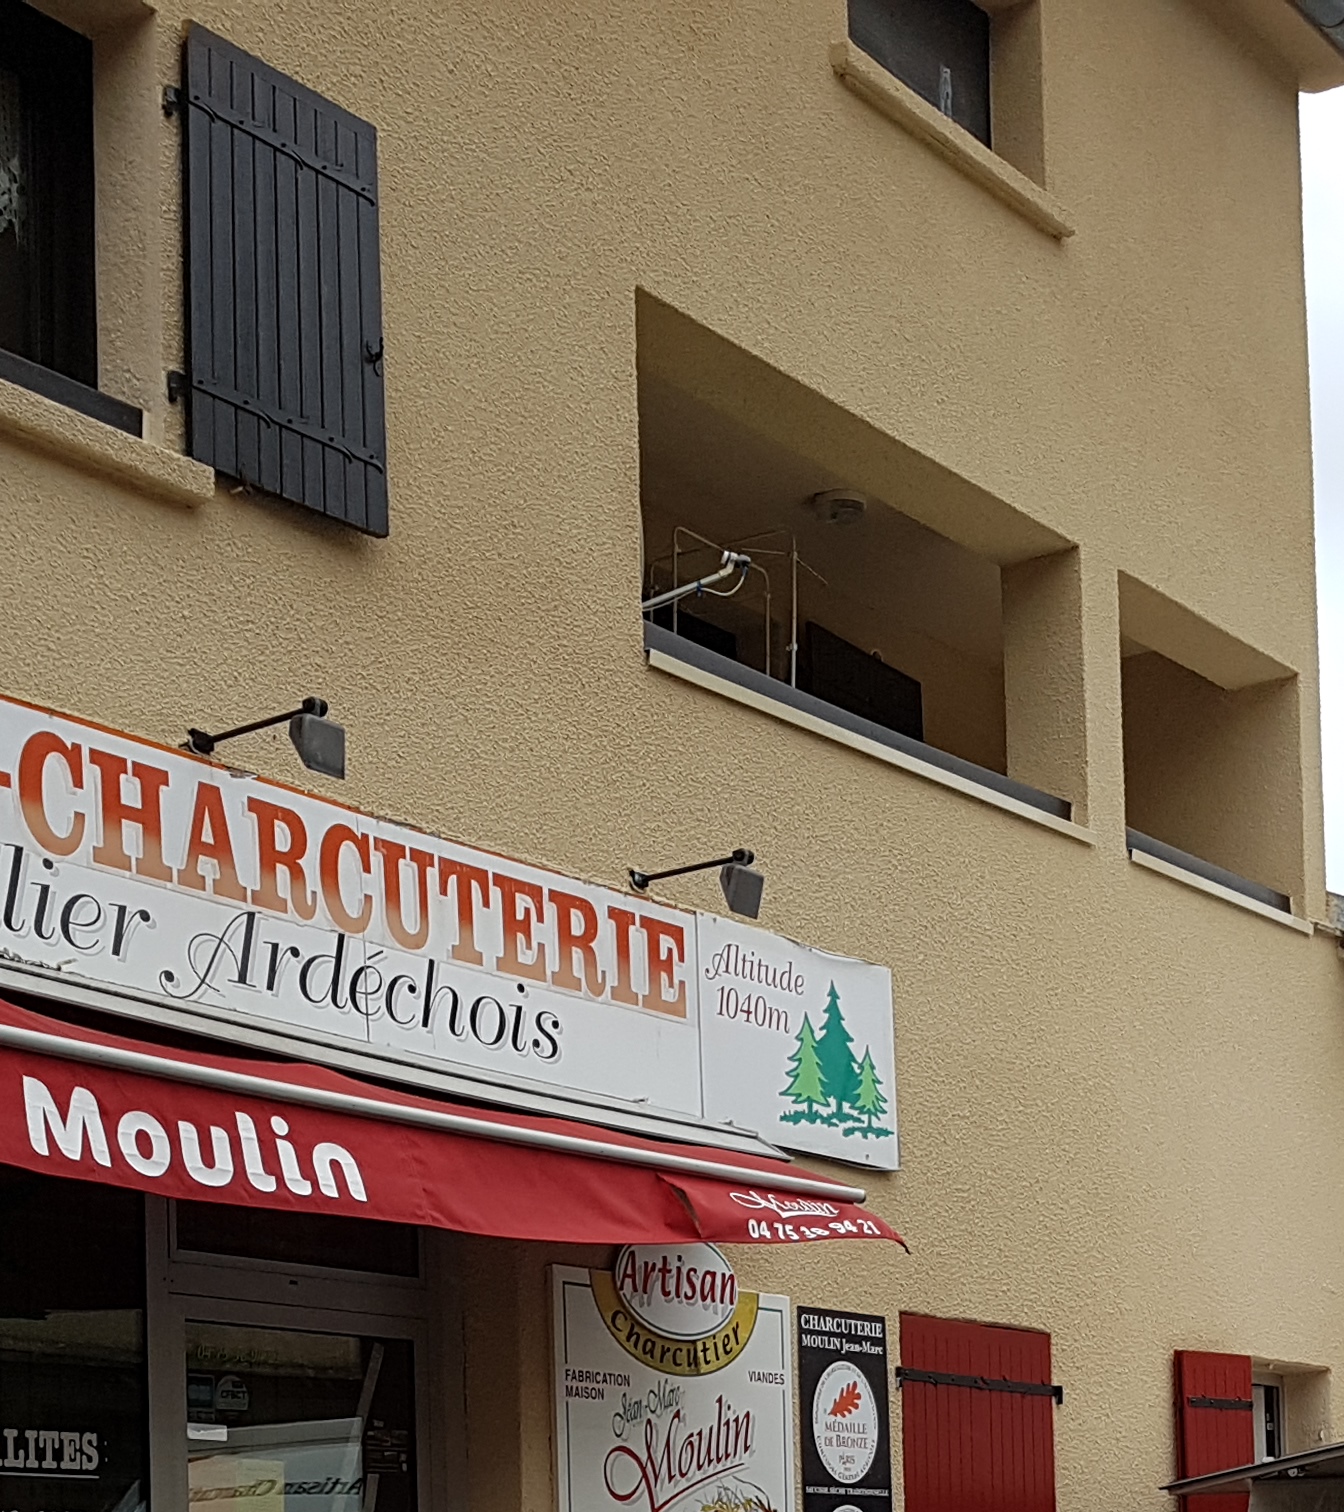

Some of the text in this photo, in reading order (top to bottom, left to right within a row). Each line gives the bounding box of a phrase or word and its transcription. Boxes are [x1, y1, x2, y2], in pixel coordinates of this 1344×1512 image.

[704, 943, 806, 997] Altitude
[160, 910, 563, 1062] Ardéchois
[716, 984, 791, 1034] 1040m
[22, 1075, 368, 1202] Moulin
[748, 1218, 772, 1239] 04
[773, 1222, 799, 1240] 75
[828, 1219, 858, 1234] 94
[856, 1219, 881, 1235] 21
[618, 1249, 736, 1306] Artisan
[801, 1313, 883, 1338] CHARCUTERIE
[611, 1308, 741, 1369] Charcutier
[802, 1333, 884, 1356] MOULIN Jean-Marc
[564, 1368, 631, 1388] FABRICATION
[748, 1370, 785, 1386] VIANDES
[564, 1386, 605, 1401] MAISON
[824, 1419, 868, 1435] MÉDAILLE
[836, 1434, 869, 1450] BRONZE
